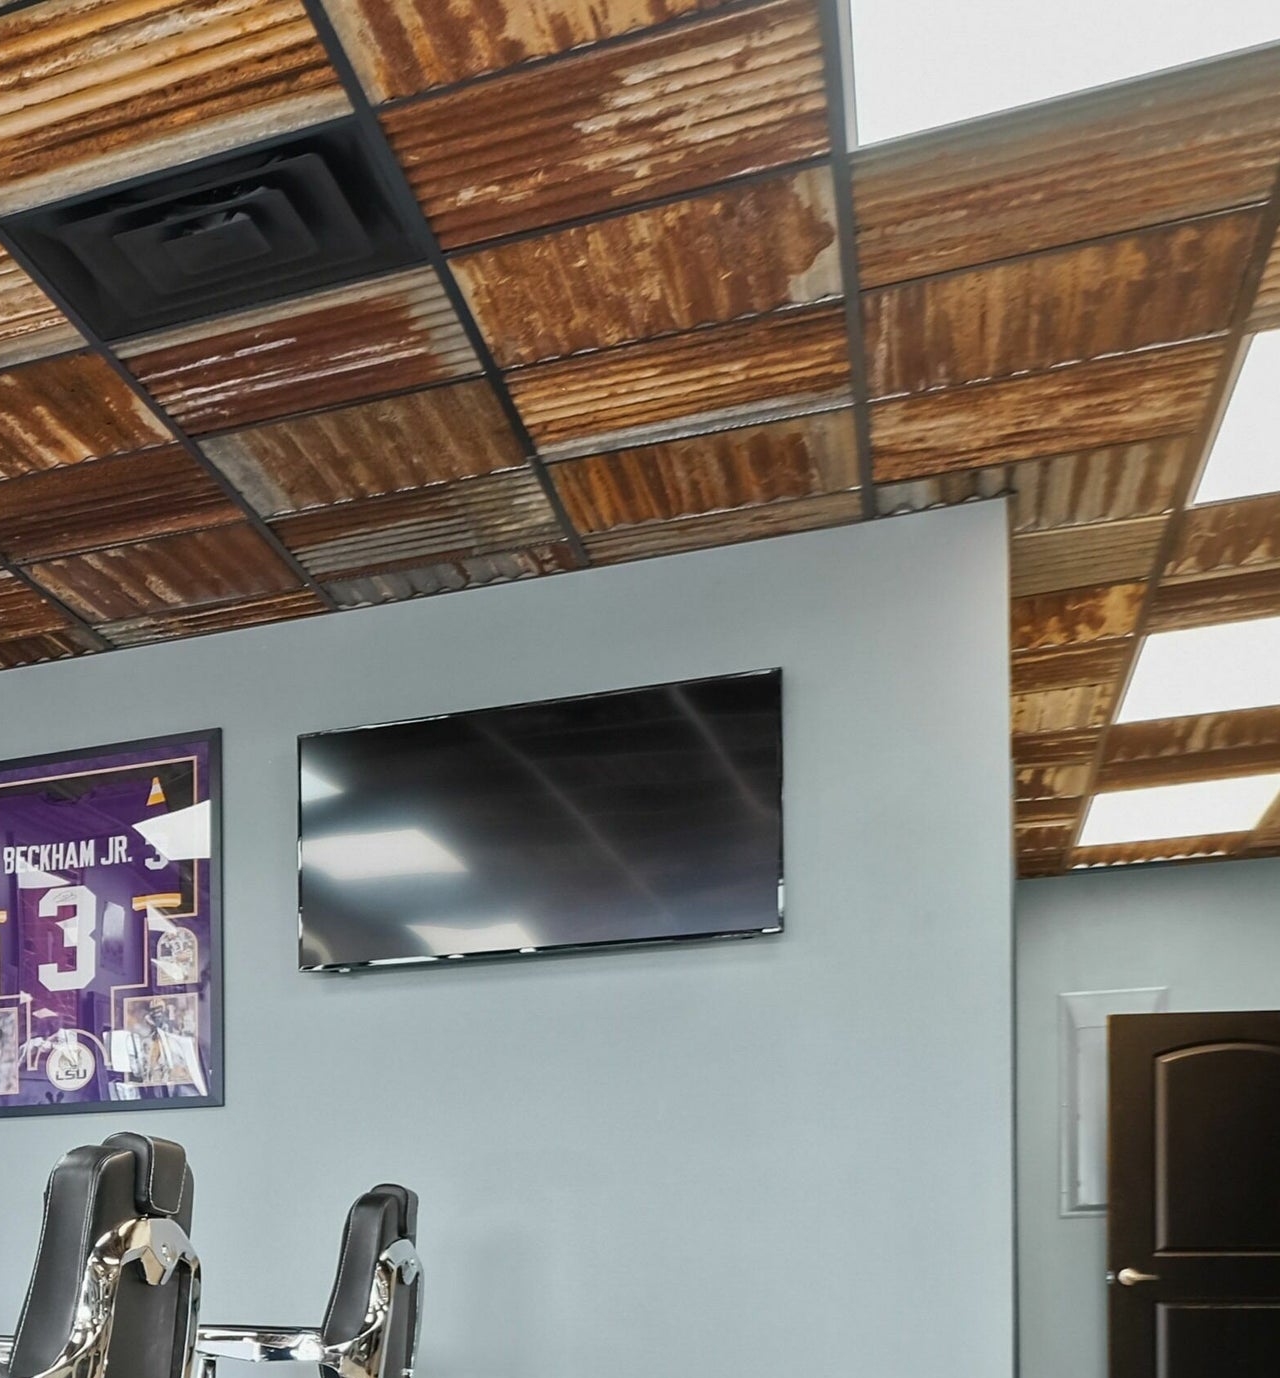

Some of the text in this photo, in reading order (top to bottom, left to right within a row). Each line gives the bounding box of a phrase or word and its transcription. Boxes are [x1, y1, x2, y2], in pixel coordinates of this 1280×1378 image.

[3, 836, 133, 874] BECKHAM JR.
[37, 885, 96, 992] 3
[56, 1069, 87, 1081] LSU
